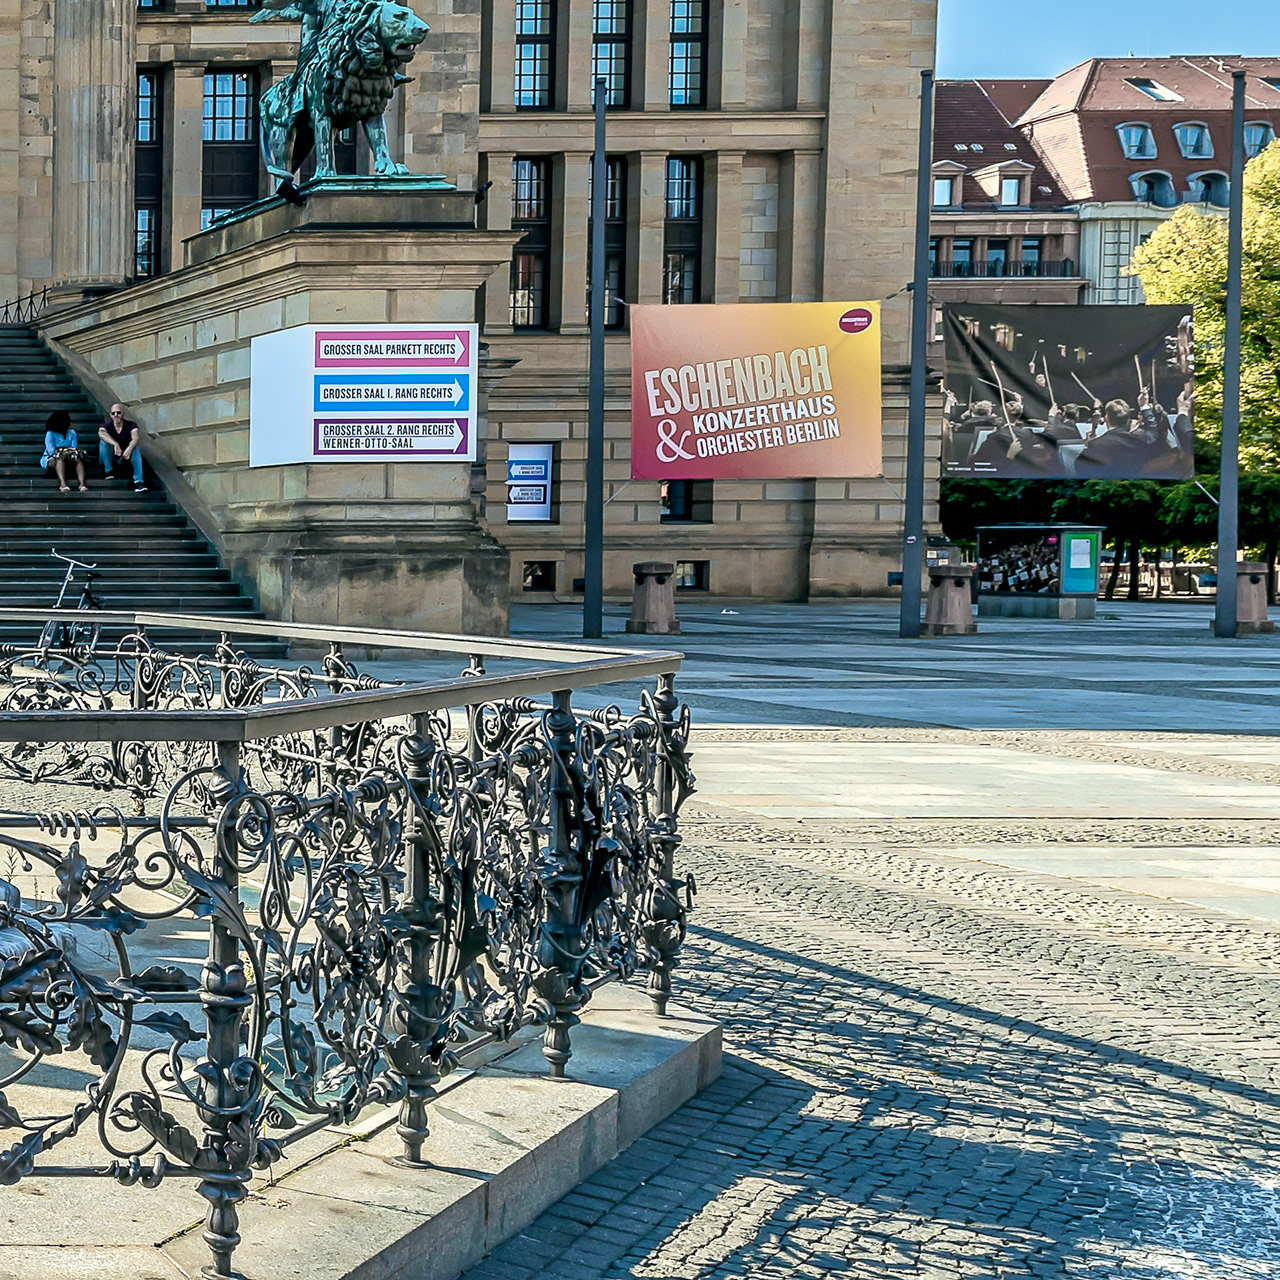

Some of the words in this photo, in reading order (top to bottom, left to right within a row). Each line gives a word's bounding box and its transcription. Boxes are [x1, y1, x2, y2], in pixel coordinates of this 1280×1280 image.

[324, 343, 362, 355] GROSSER
[363, 343, 384, 355] SAAL
[385, 343, 422, 355] PARKETT
[424, 343, 456, 355] RECHTS
[644, 345, 833, 417] ESCHENBACH
[323, 388, 362, 399] GROSSER
[364, 388, 385, 399] SAAL
[395, 388, 418, 399] RANG
[420, 388, 453, 399] RECHTS
[692, 394, 837, 435] KONZERTHAUS
[323, 424, 362, 436] GROSSER
[364, 424, 385, 436] SAAL
[387, 424, 395, 436] 2.
[397, 424, 420, 436] RANG
[422, 424, 455, 436] RECHTS
[323, 437, 414, 449] WERNER-OTTO-SAAL
[655, 419, 697, 463] &
[696, 425, 784, 459] ORCHESTER
[785, 417, 841, 446] BERLIN
